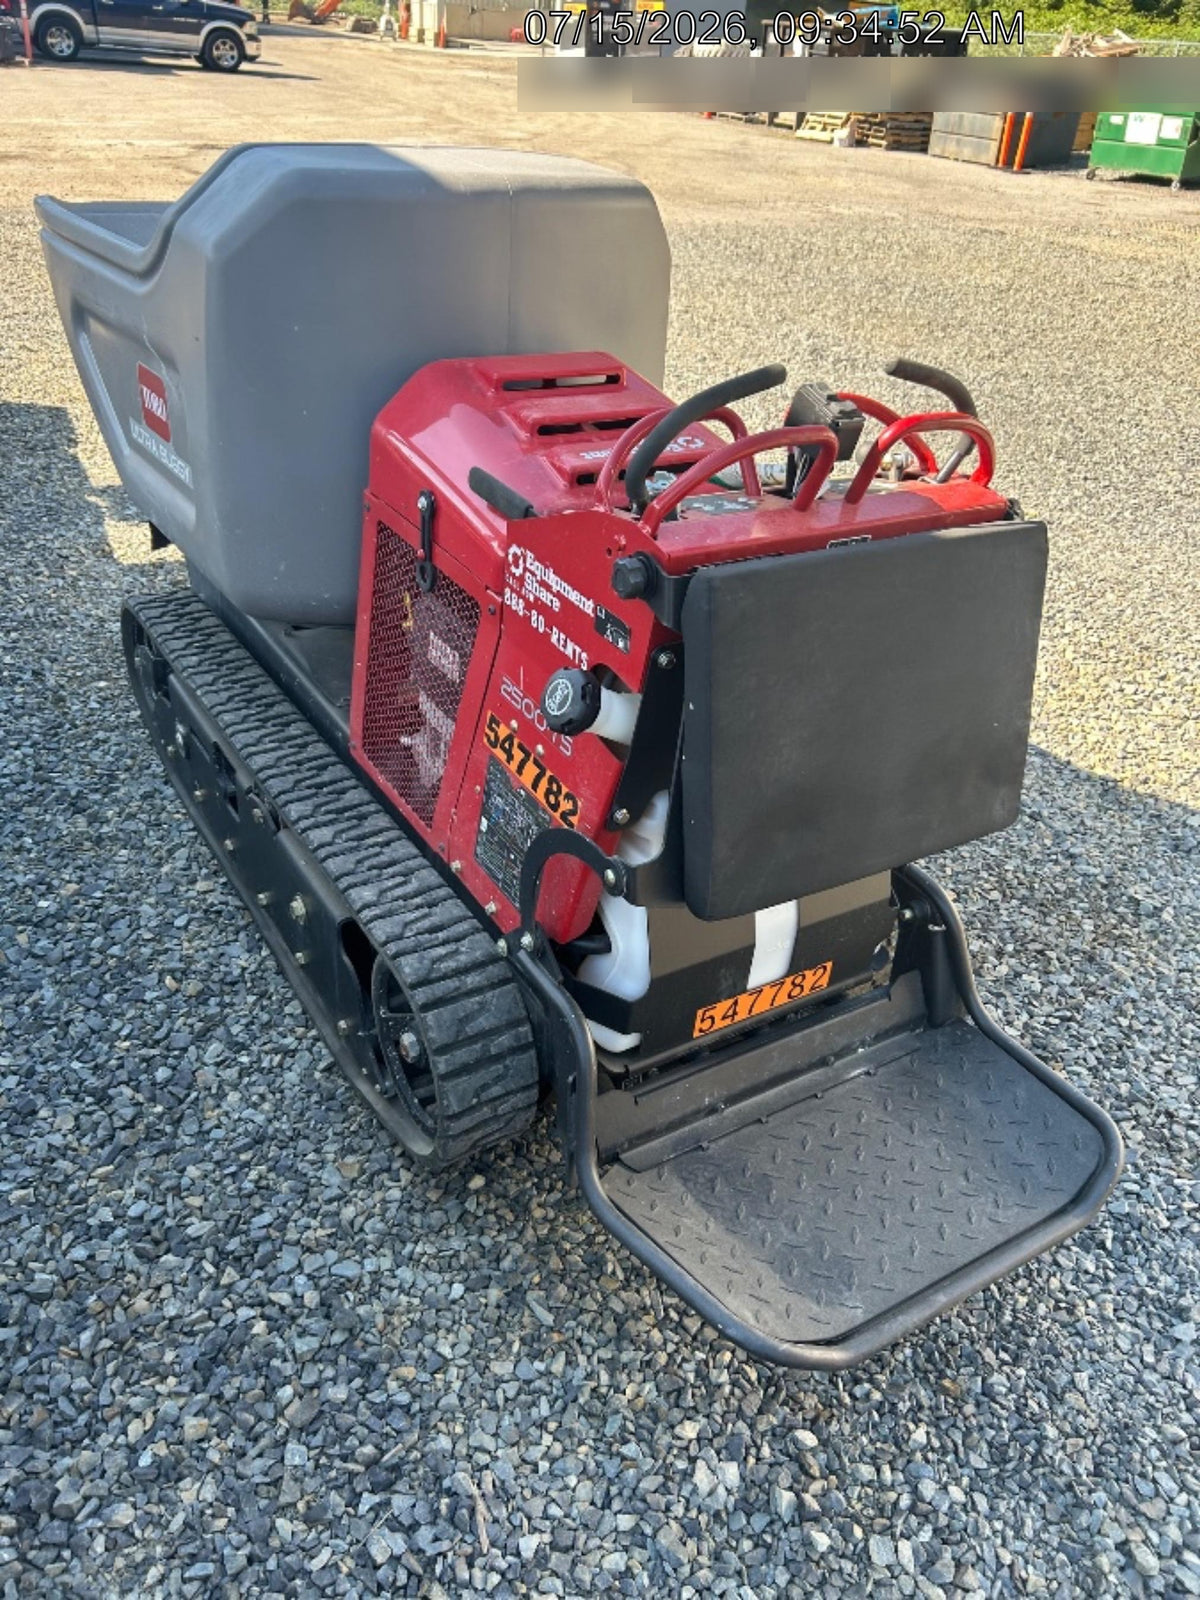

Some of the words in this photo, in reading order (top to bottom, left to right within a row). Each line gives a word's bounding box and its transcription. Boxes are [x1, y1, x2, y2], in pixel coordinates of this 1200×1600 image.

[524, 572, 561, 613] Share
[525, 550, 596, 618] Equipment
[504, 587, 589, 671] 888-80-RENTS
[501, 675, 574, 757] 2500S
[484, 712, 579, 829] 547782
[698, 964, 828, 1034] 547782
